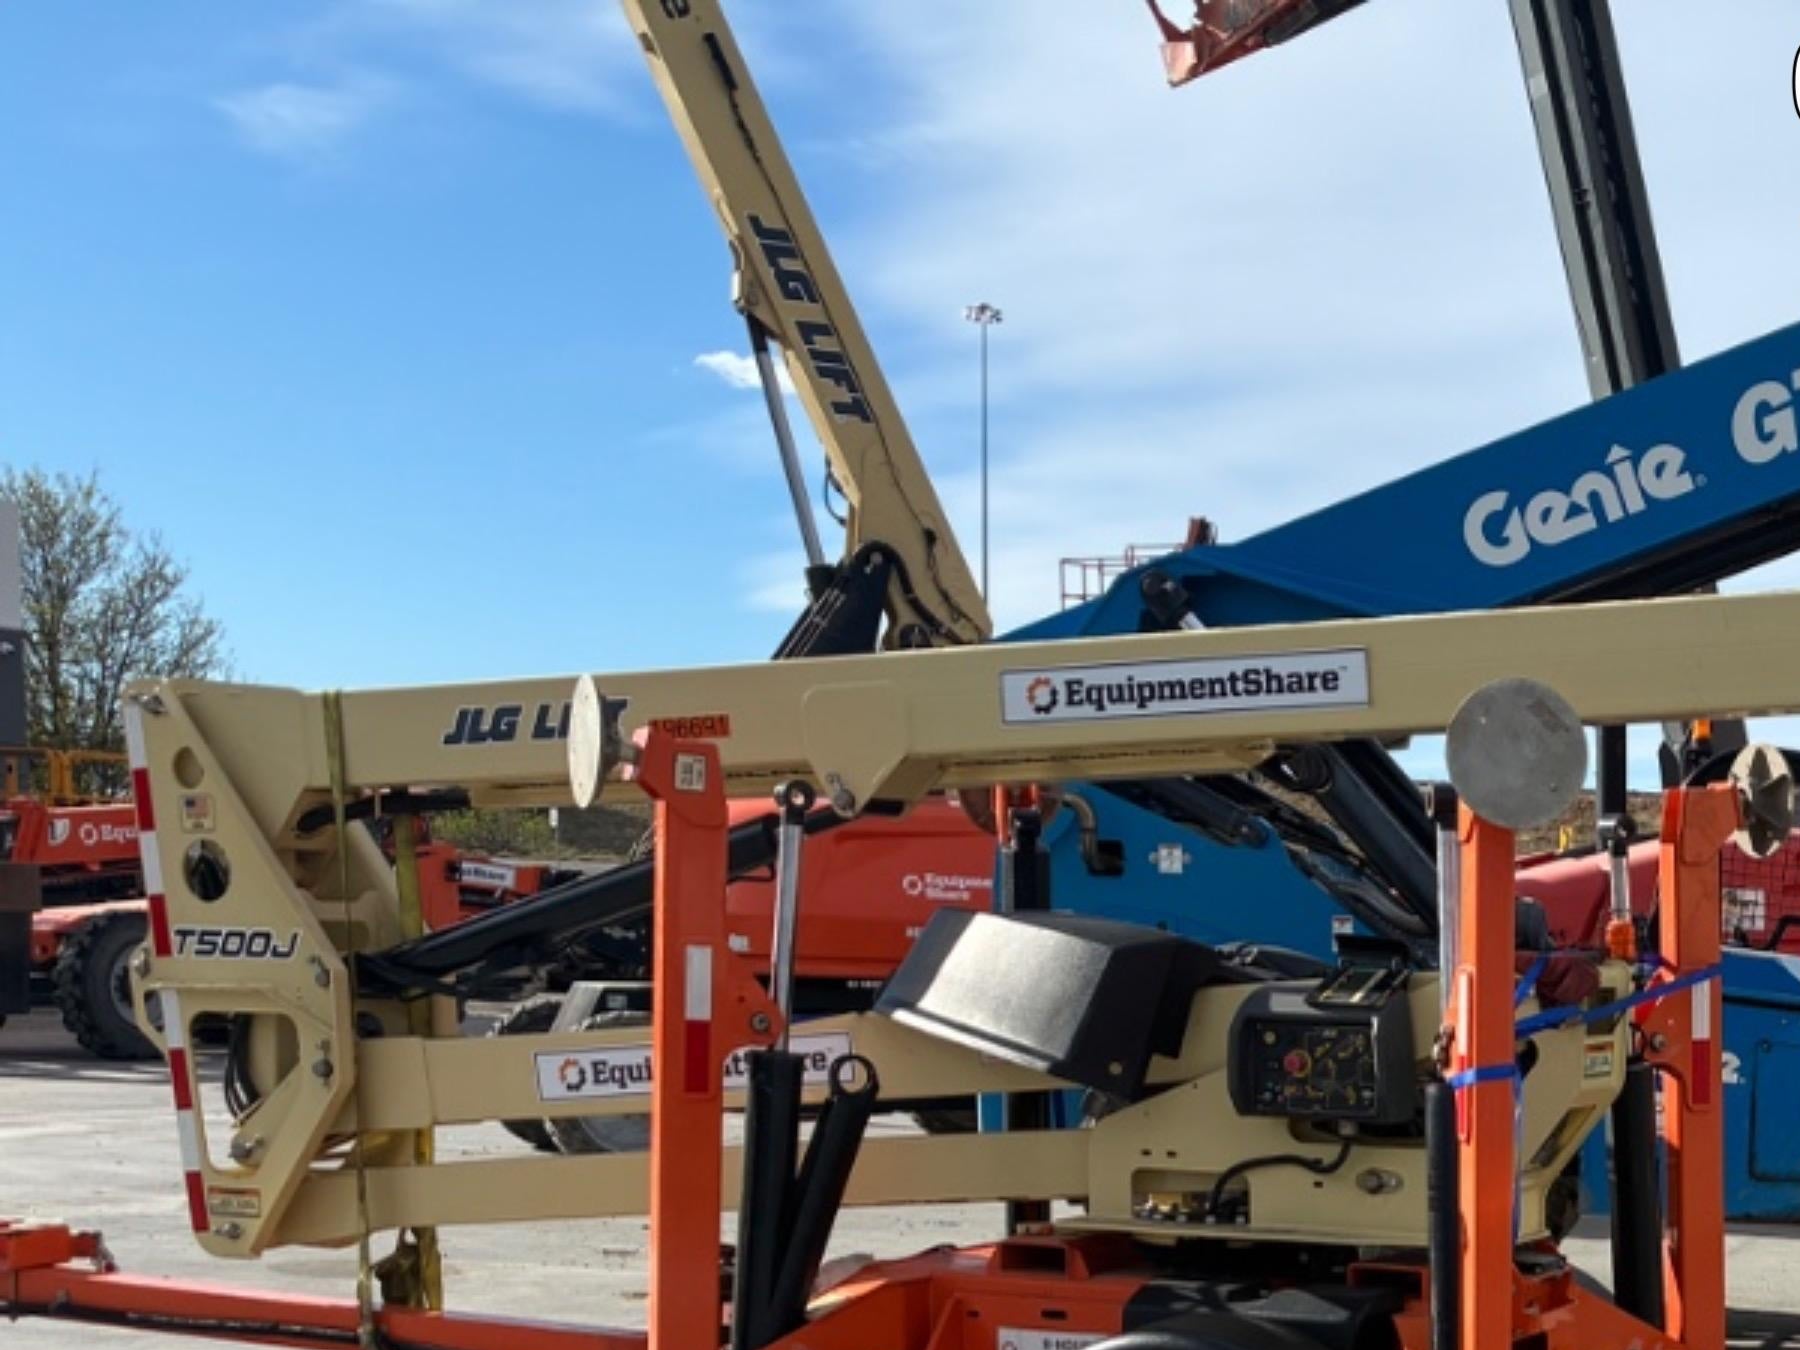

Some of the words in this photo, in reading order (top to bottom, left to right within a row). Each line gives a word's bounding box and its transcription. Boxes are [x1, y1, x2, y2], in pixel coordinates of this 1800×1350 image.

[747, 212, 820, 304] JLG
[794, 319, 876, 424] LIFT
[1463, 443, 1695, 567] Genie
[1063, 667, 1342, 712] EquipmentShare
[442, 704, 524, 746] JLG
[173, 927, 299, 958] T500J
